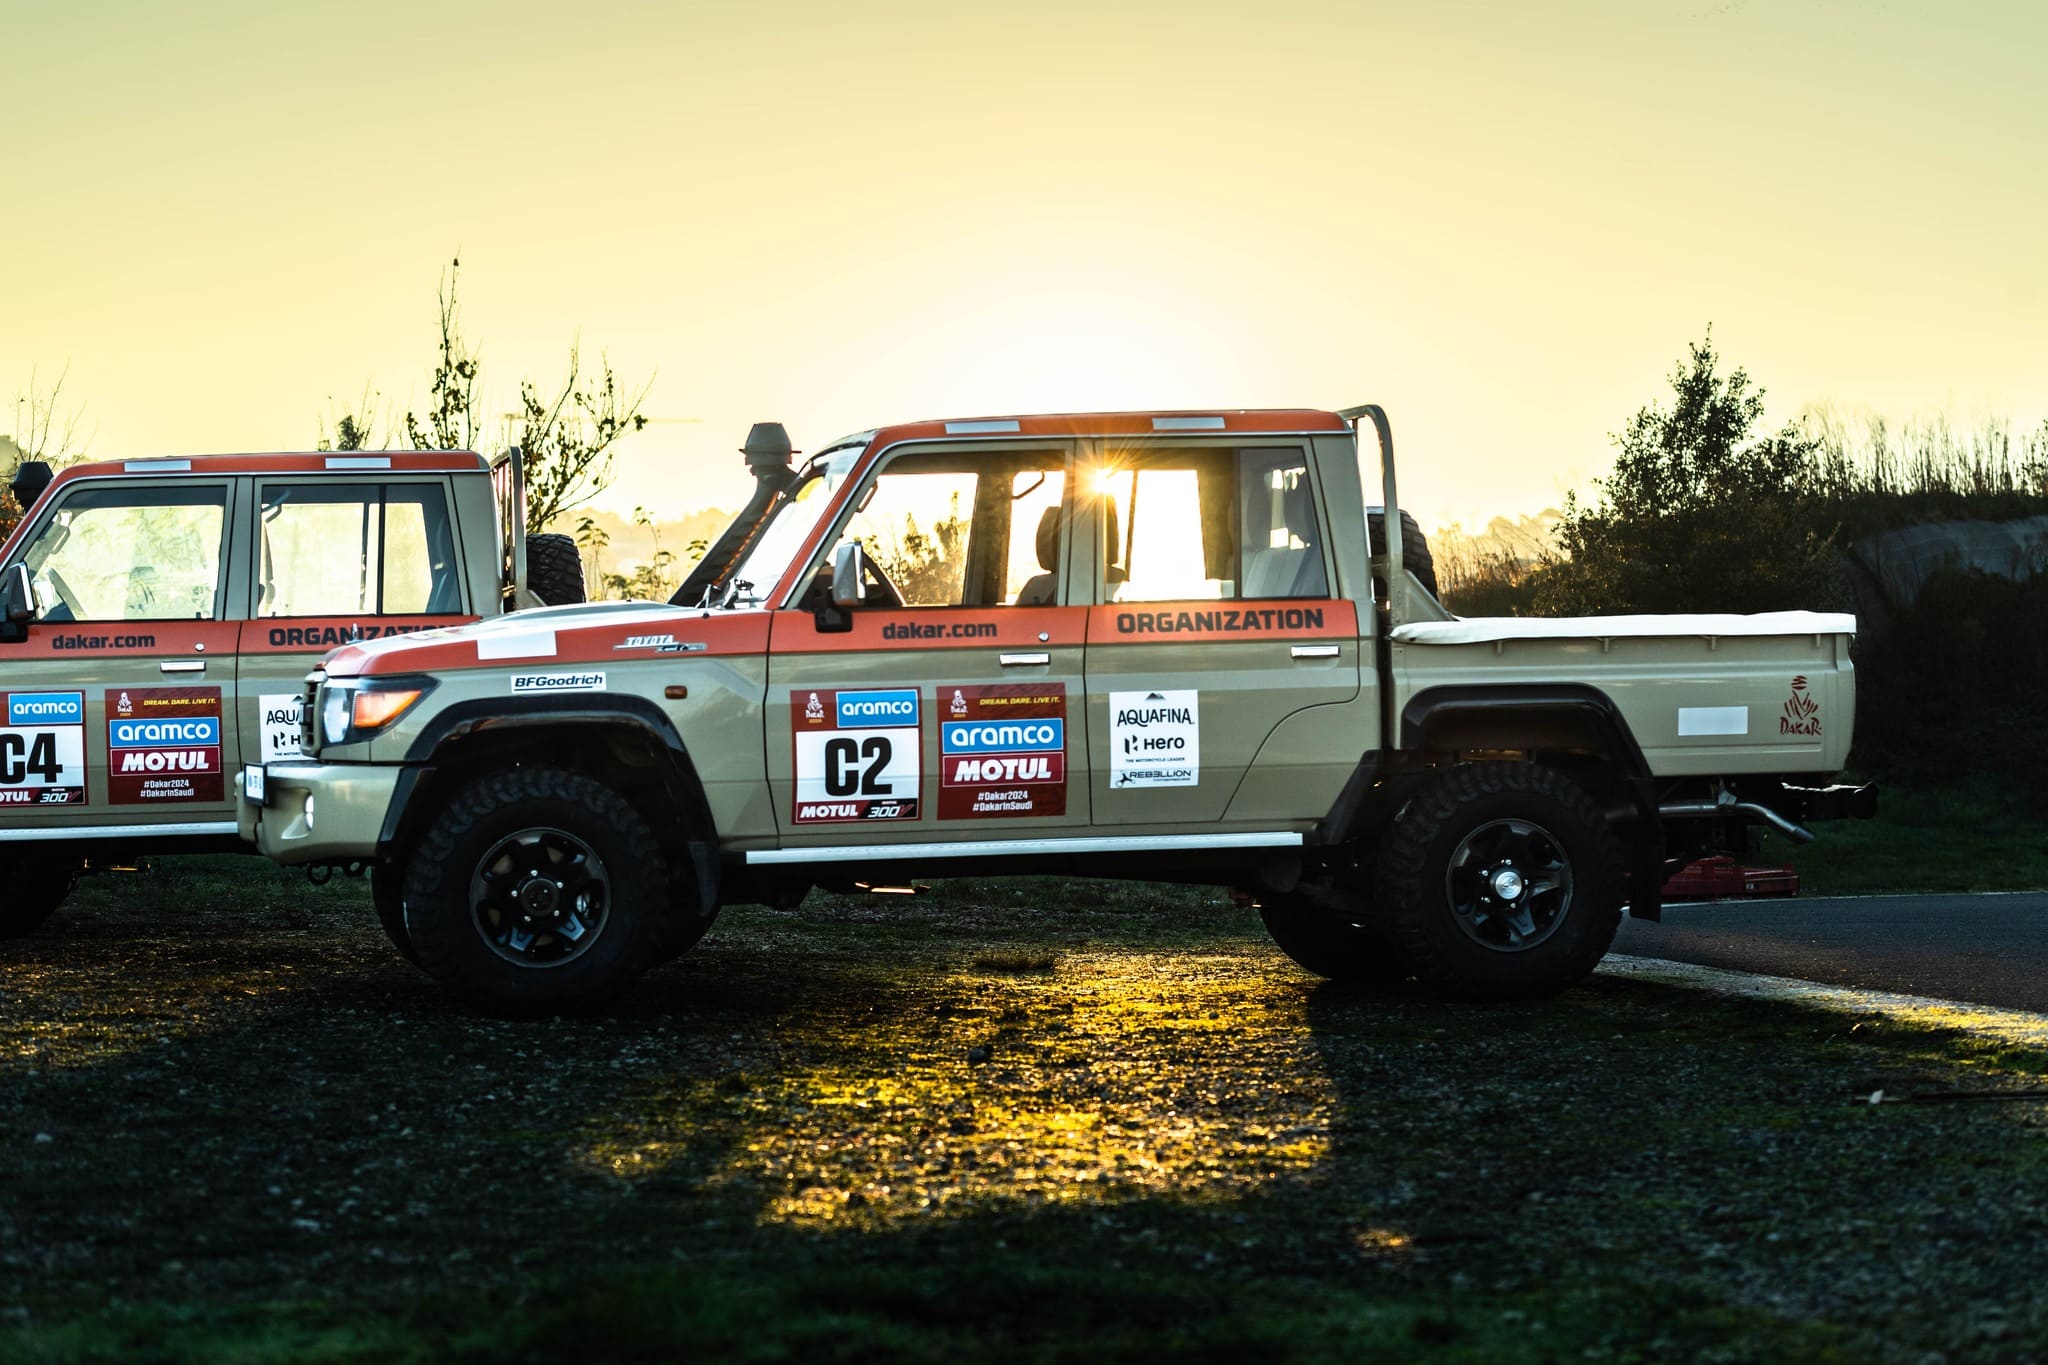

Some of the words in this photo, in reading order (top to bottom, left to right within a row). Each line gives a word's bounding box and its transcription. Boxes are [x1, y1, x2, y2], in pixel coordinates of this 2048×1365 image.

[1117, 608, 1324, 634] ORGANIZATION
[882, 621, 998, 640] dakar.com
[52, 634, 156, 650] dakar.com
[624, 634, 674, 646] TOYOTA
[514, 675, 603, 687] BFGoodrich
[13, 702, 78, 715] aramco
[842, 701, 913, 716] aramco
[979, 698, 1009, 706] DREAM.
[1117, 707, 1192, 728] AQUAFINA
[1780, 716, 1822, 736] DAKAR
[118, 723, 211, 741] aramco
[951, 725, 1055, 747] aramco
[1143, 737, 1185, 750] Hero
[0, 732, 63, 785] C4
[121, 751, 210, 772] MOTUL
[824, 736, 893, 797] C2
[953, 757, 1053, 782] MOTUL
[144, 779, 190, 789] #Dakar2024
[978, 790, 1029, 801] #Dakar2024
[800, 804, 859, 819] MOTUL
